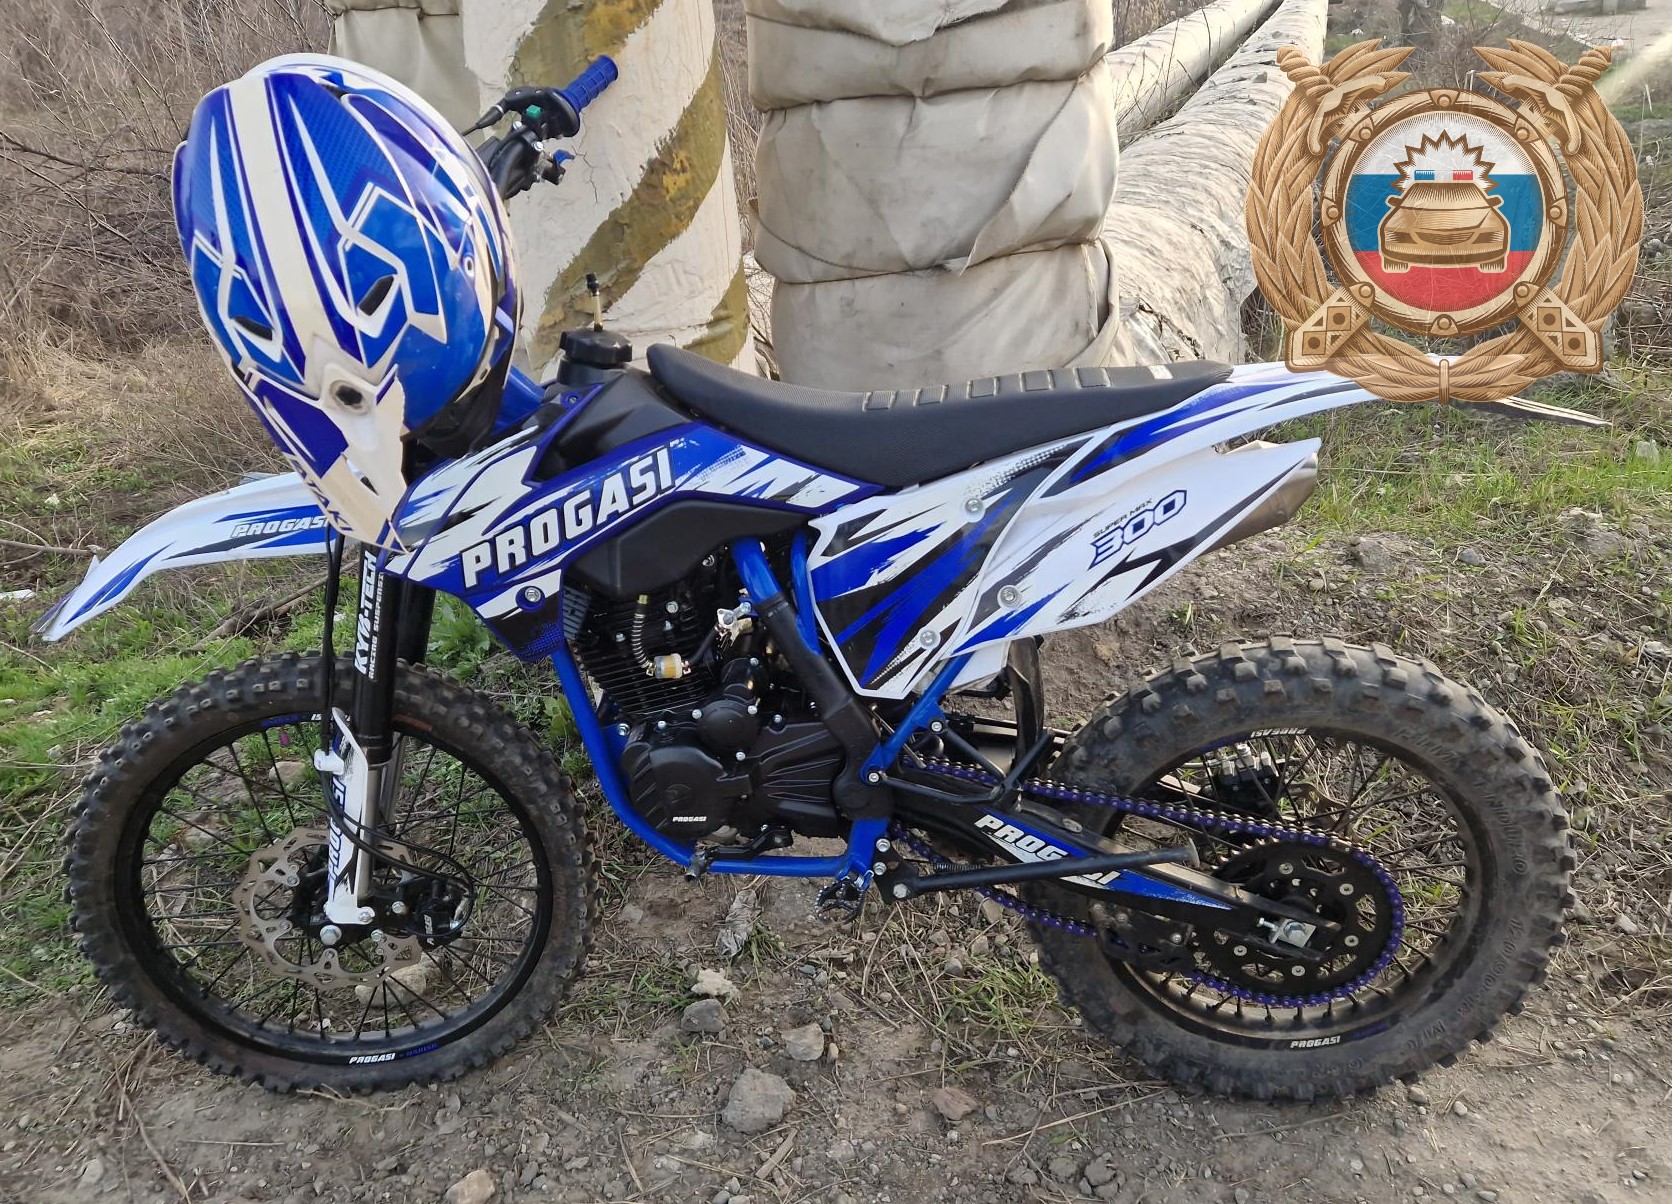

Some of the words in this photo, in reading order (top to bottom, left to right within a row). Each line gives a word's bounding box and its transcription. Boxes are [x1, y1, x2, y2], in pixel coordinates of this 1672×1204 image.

[461, 447, 676, 588] PROGASI
[1086, 489, 1187, 571] 300
[1093, 514, 1128, 539] SUPER
[1129, 498, 1153, 516] MAX
[368, 635, 378, 680] RACING
[373, 571, 385, 632] SUSPENSI
[974, 814, 1121, 885] PROGI
[348, 1052, 396, 1065] PROGASI
[1290, 1035, 1341, 1049] PROGASI
